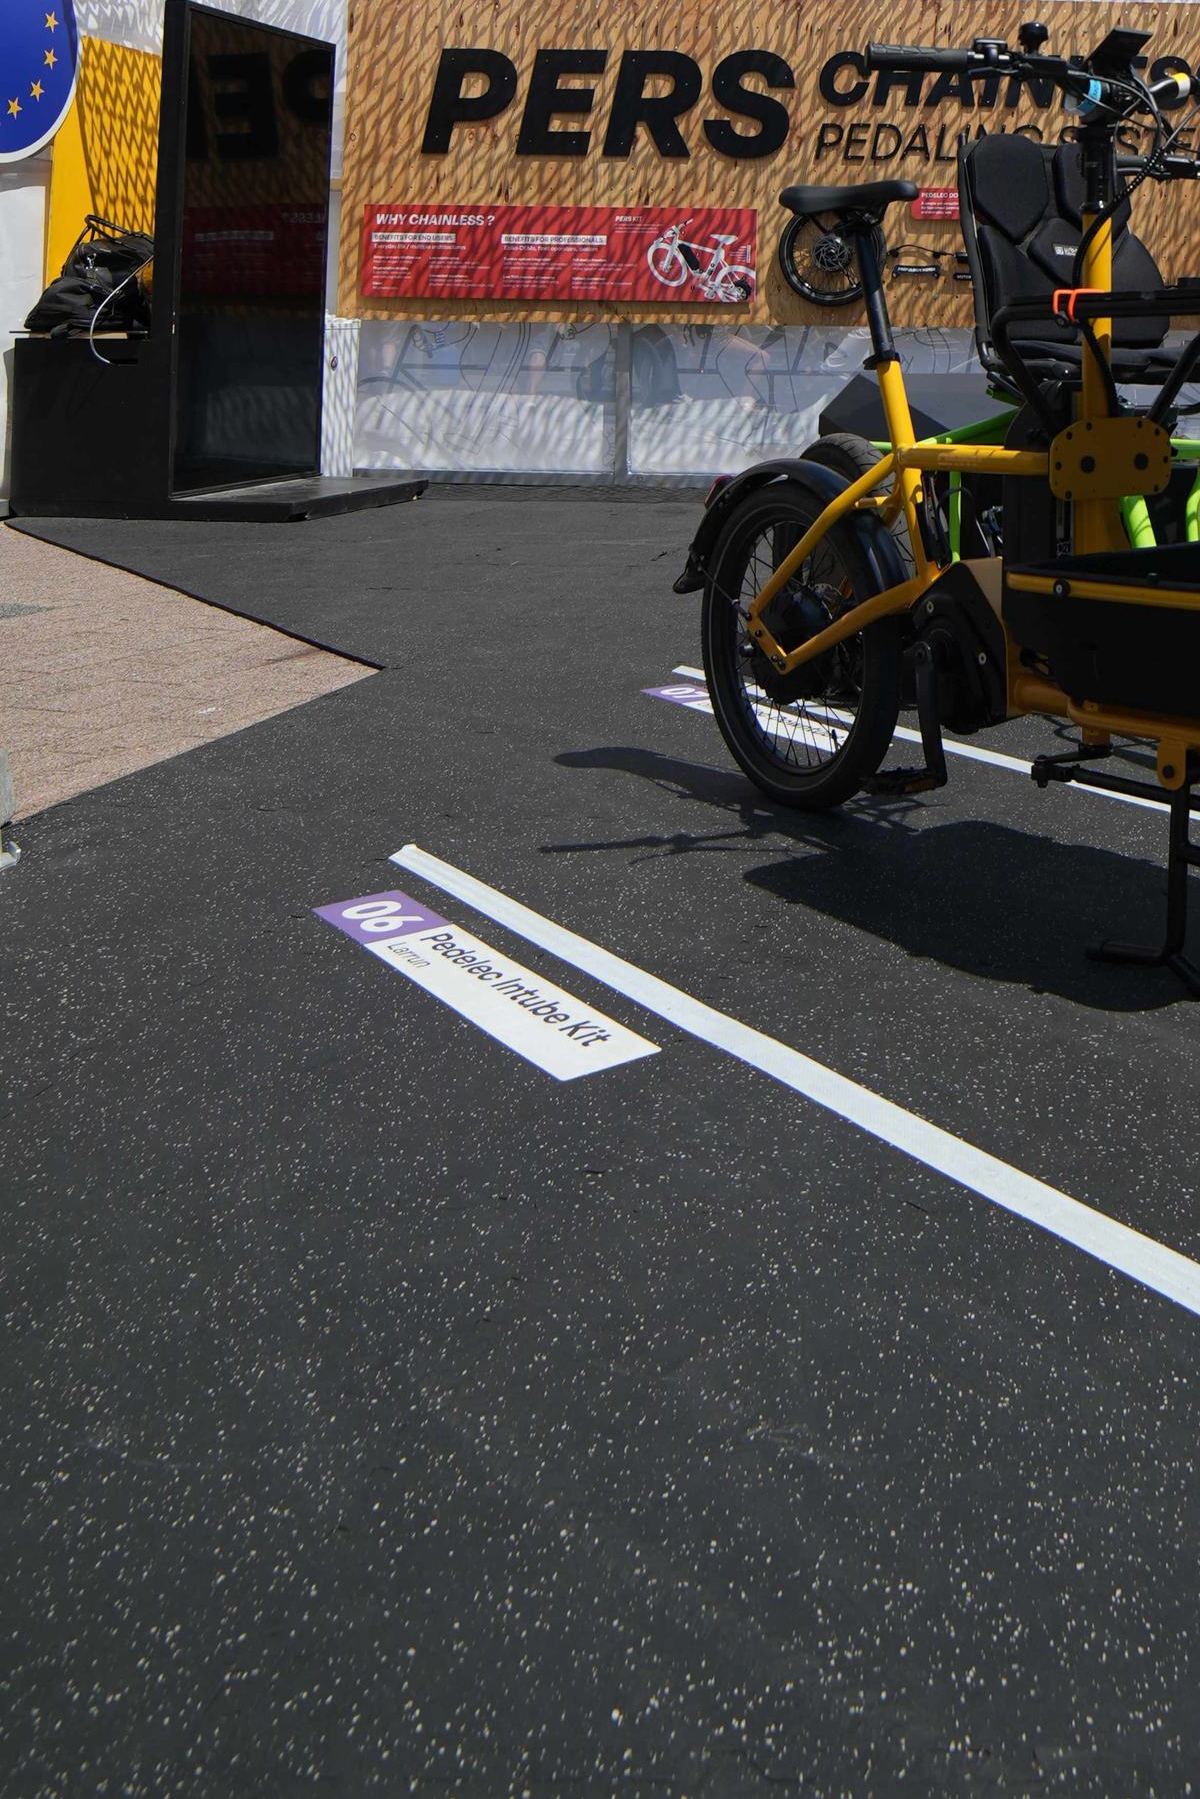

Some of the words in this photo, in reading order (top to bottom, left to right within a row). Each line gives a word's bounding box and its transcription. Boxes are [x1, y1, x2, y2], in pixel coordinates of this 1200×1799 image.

[420, 48, 796, 158] PERS
[376, 213, 406, 225] WHY
[408, 214, 485, 226] CHAINLESS
[487, 215, 495, 226] ?
[550, 236, 604, 244] PROFESSIONALS
[341, 900, 424, 933] 06
[386, 941, 431, 969] Larrun
[420, 932, 503, 982] Pedelec
[492, 978, 570, 1025] Intube
[559, 1020, 613, 1048] Kit
